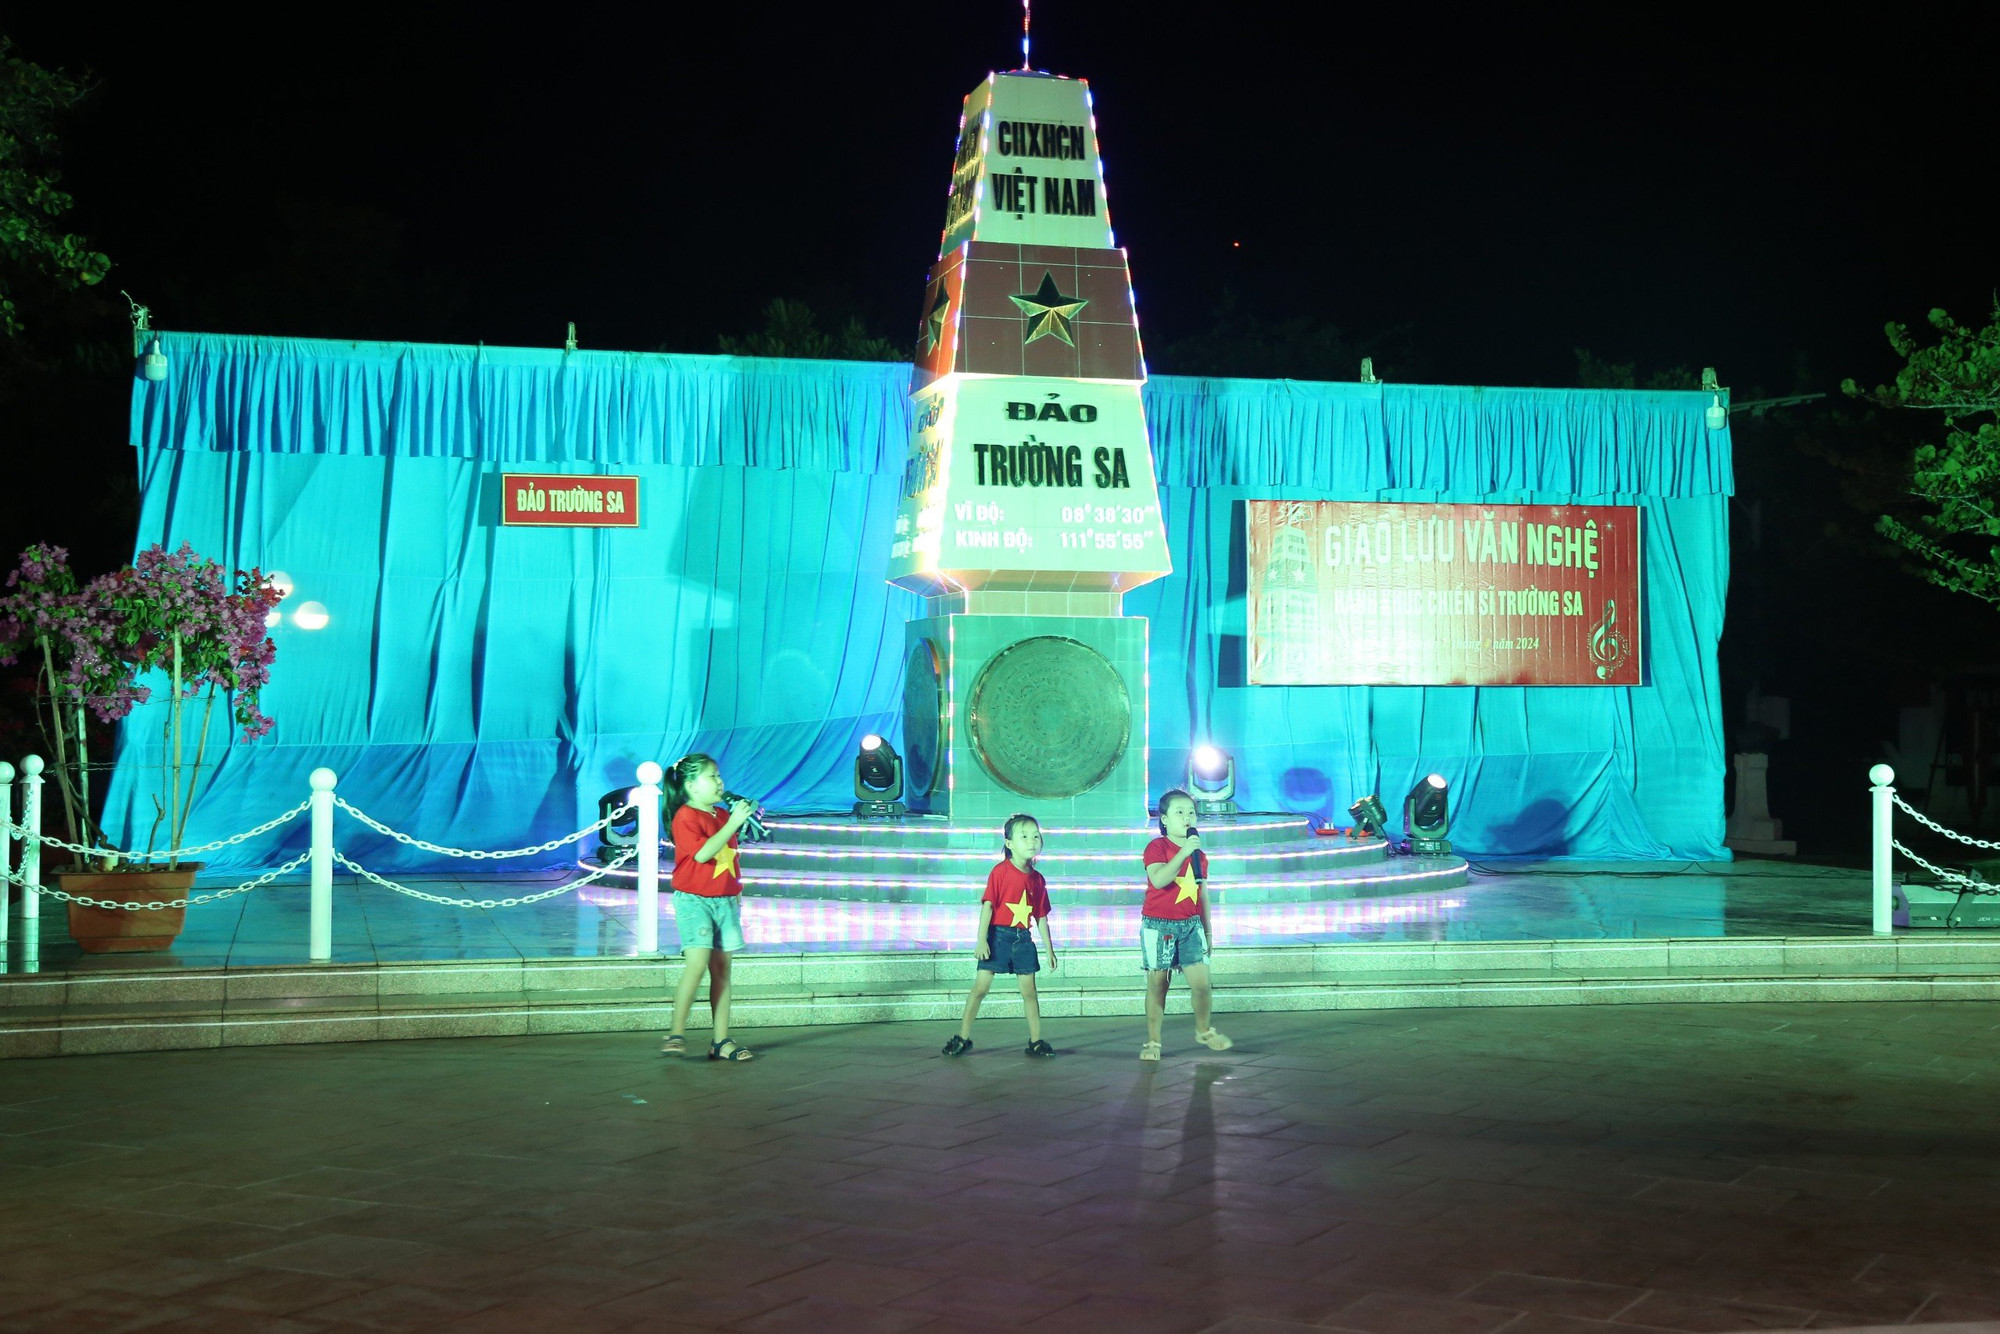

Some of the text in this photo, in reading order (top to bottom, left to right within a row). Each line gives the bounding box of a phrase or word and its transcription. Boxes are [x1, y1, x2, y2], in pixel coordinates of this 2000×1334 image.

[991, 166, 1037, 220] VIỆT
[1044, 176, 1096, 217] NAM
[1005, 392, 1098, 423] ĐẢO
[973, 434, 1083, 487] TRƯỜNG
[1094, 446, 1130, 489] SA
[517, 482, 625, 514] ĐẢO TRƯỜNG SA
[955, 530, 999, 548] KINH
[1324, 520, 1392, 567] GIAO
[1401, 514, 1455, 563] LƯU
[1463, 510, 1518, 564] VĂN
[1527, 519, 1599, 579] NGHỆ
[1498, 585, 1559, 616] TRƯỜNG
[1563, 590, 1584, 616] SA
[1493, 637, 1514, 650] năm
[1515, 637, 1540, 650] 2024
